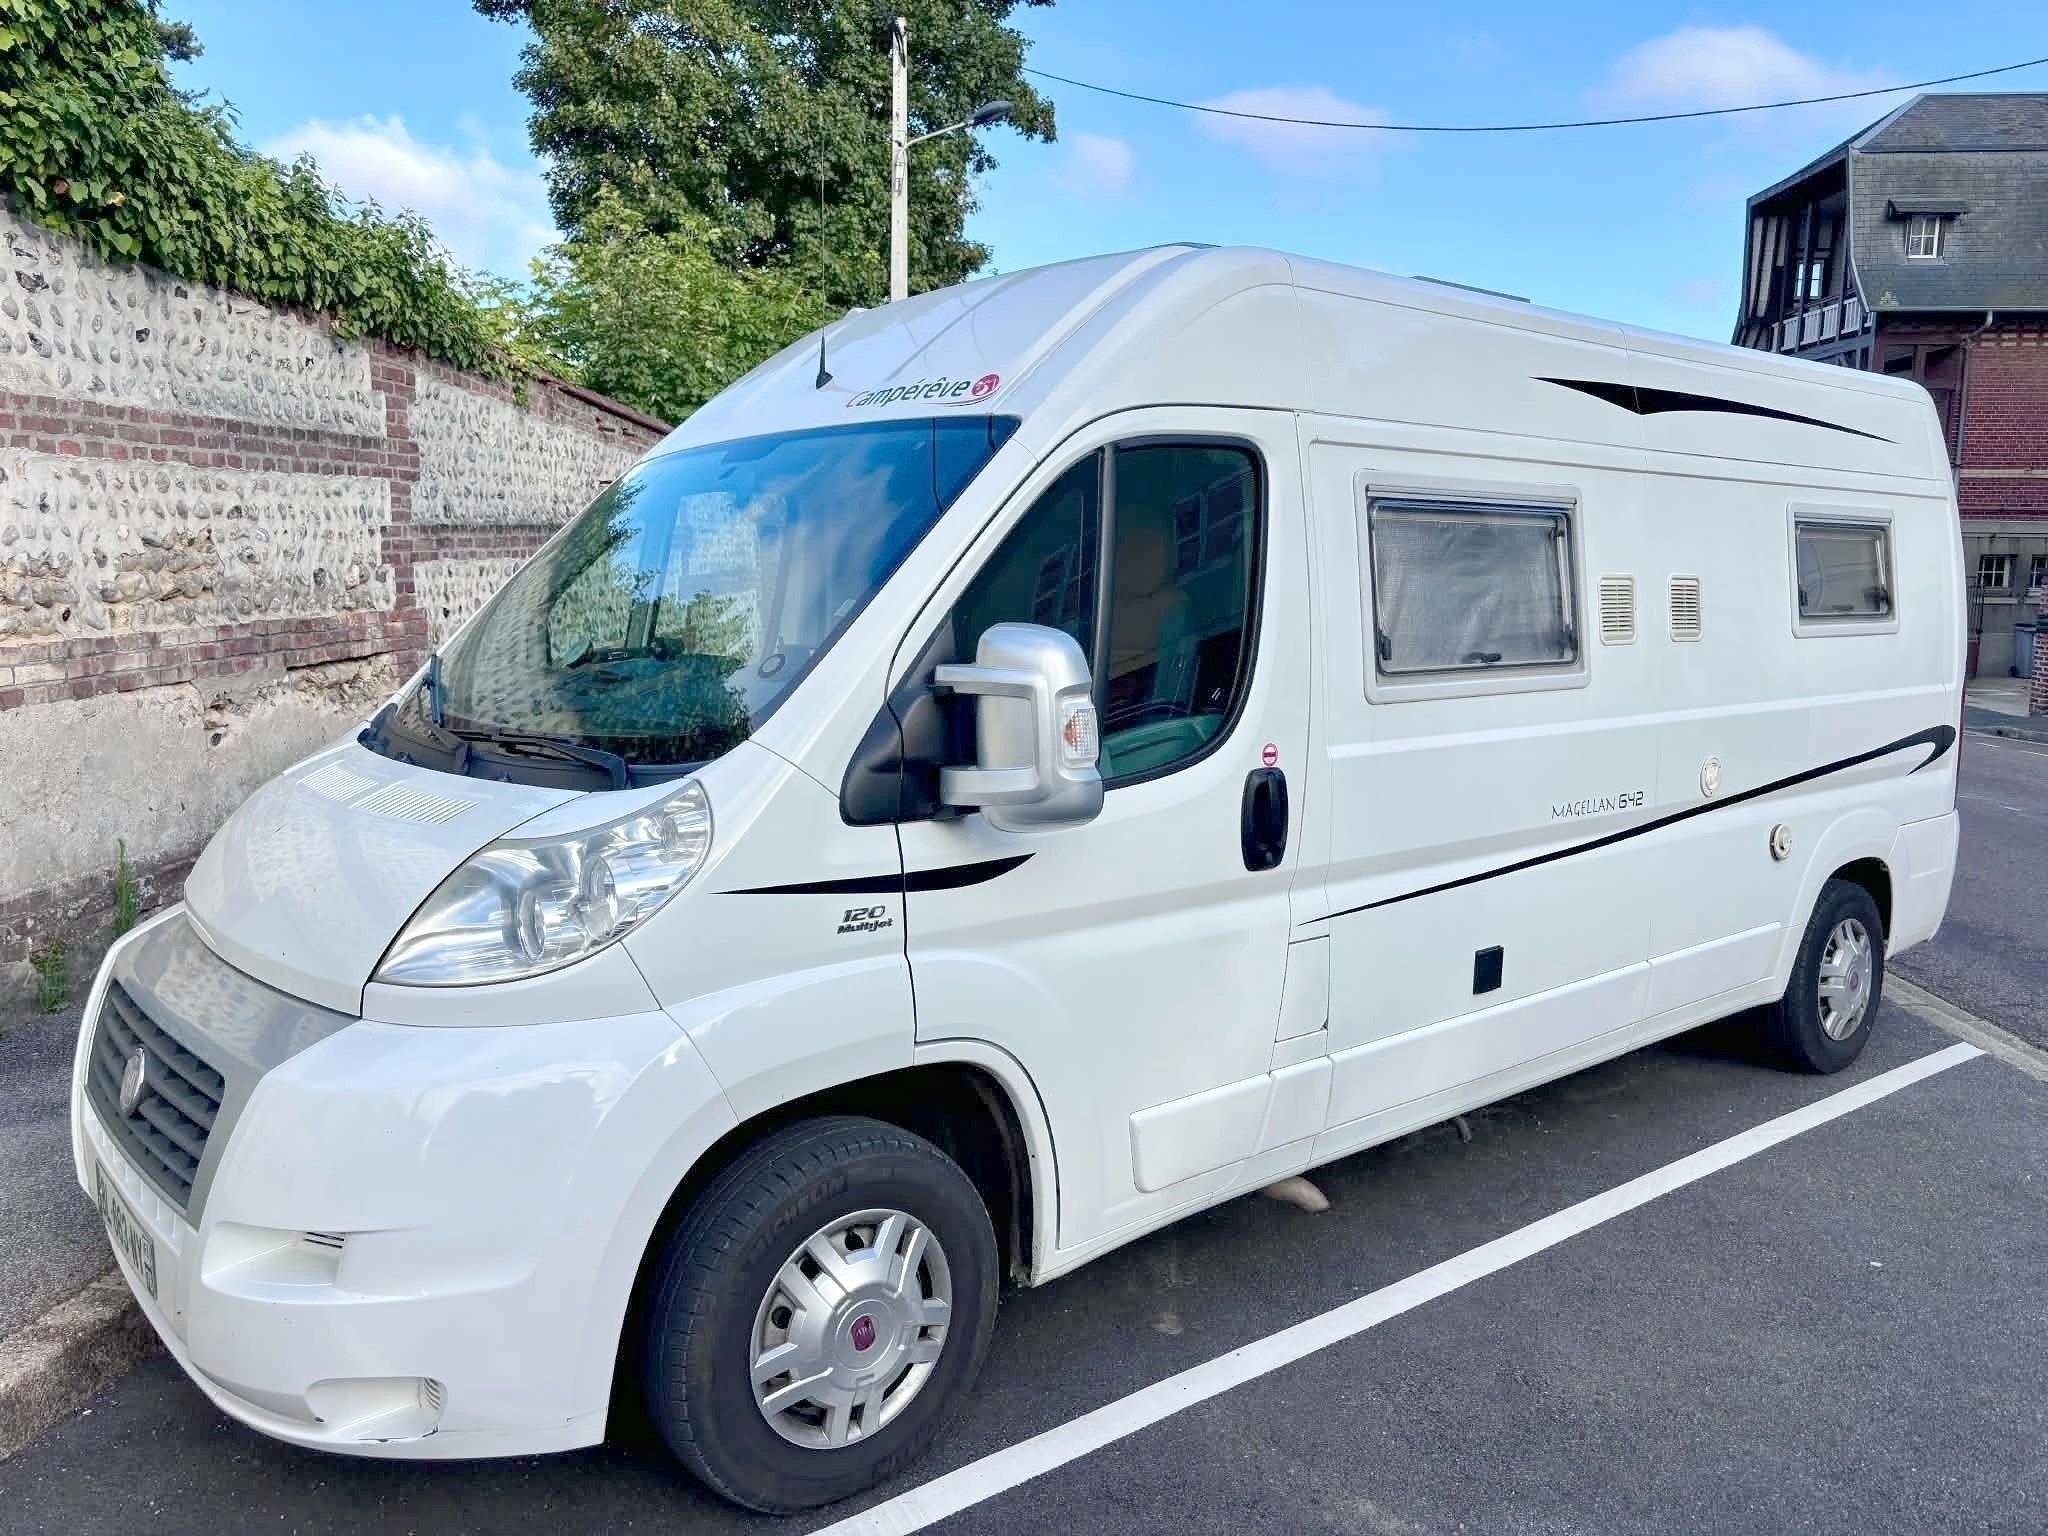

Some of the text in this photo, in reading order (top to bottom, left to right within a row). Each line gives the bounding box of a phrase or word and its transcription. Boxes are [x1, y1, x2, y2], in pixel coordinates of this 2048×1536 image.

[1551, 791, 1644, 820] MAGELLAN 642
[843, 905, 886, 923] 120
